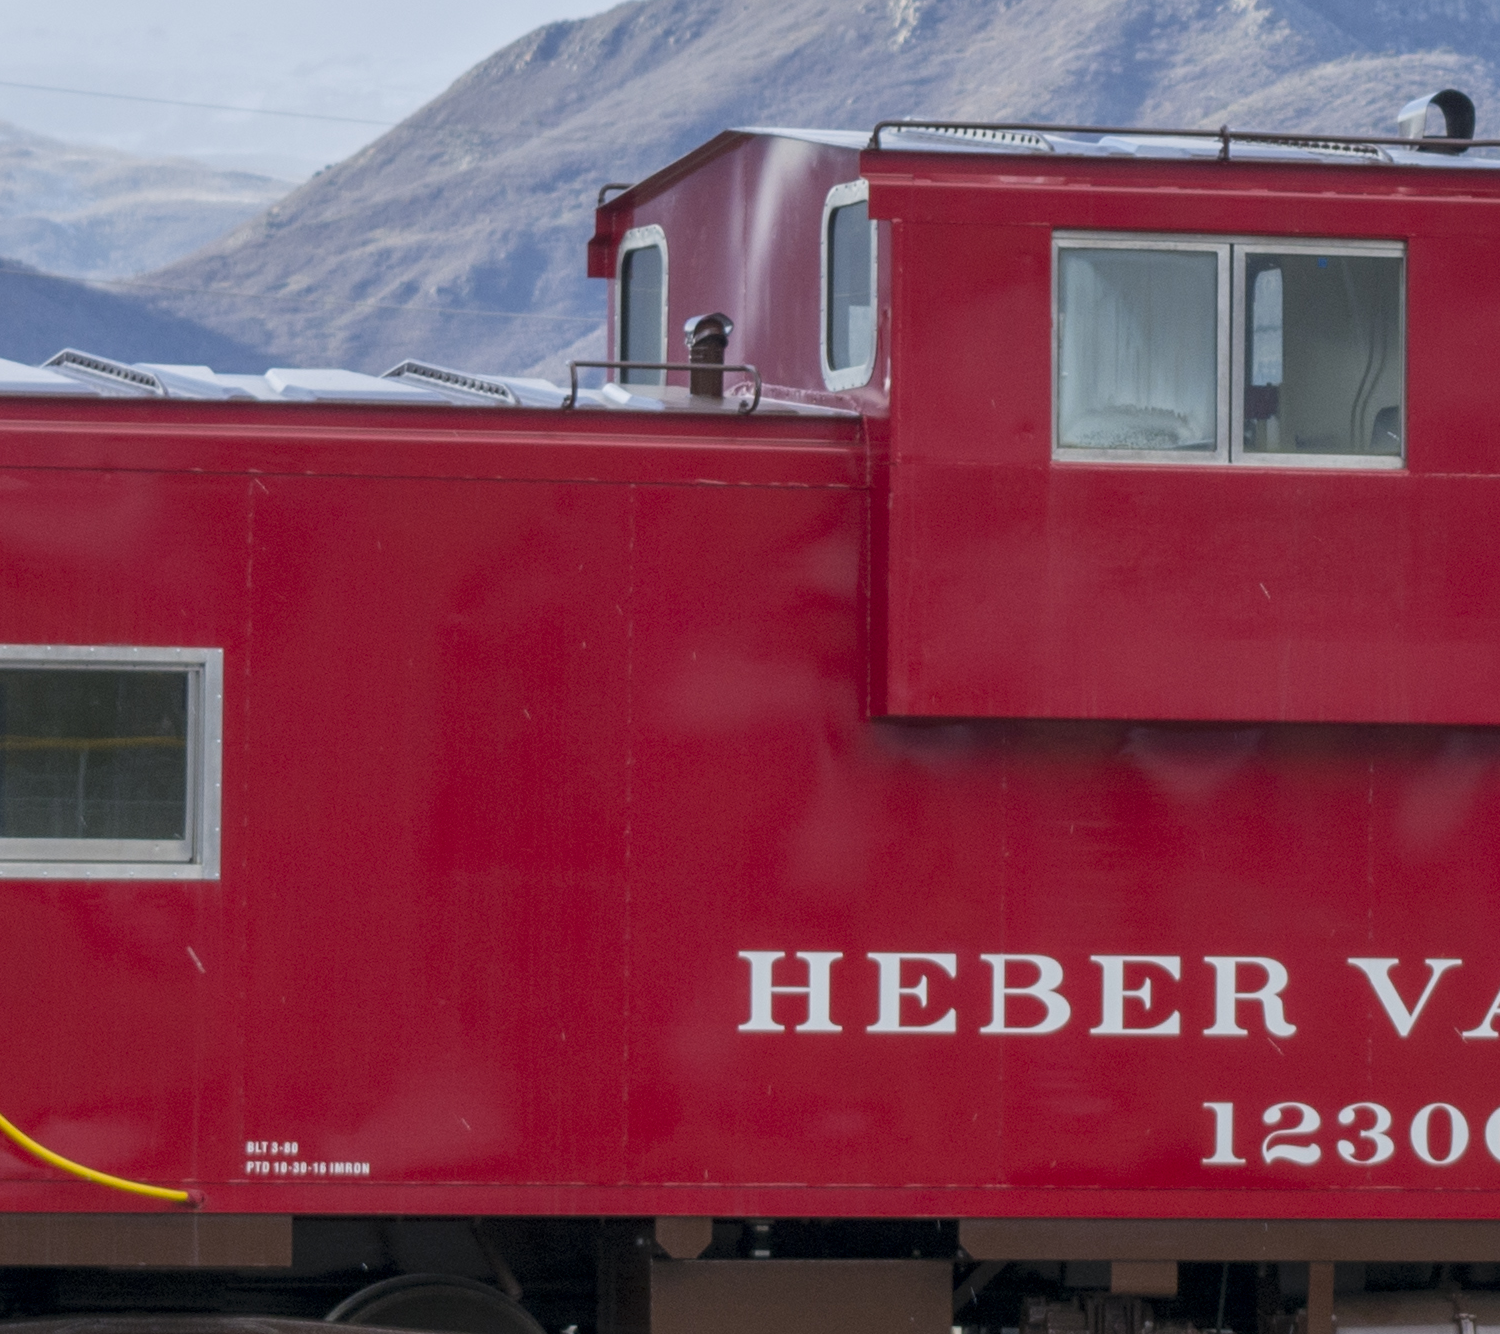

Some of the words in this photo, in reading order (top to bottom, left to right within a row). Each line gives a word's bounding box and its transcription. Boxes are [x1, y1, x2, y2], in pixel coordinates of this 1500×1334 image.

[737, 950, 1298, 1039] HEBER
[245, 1140, 269, 1155] BLT
[245, 1160, 270, 1175] PTD
[329, 1162, 370, 1176] IMRON
